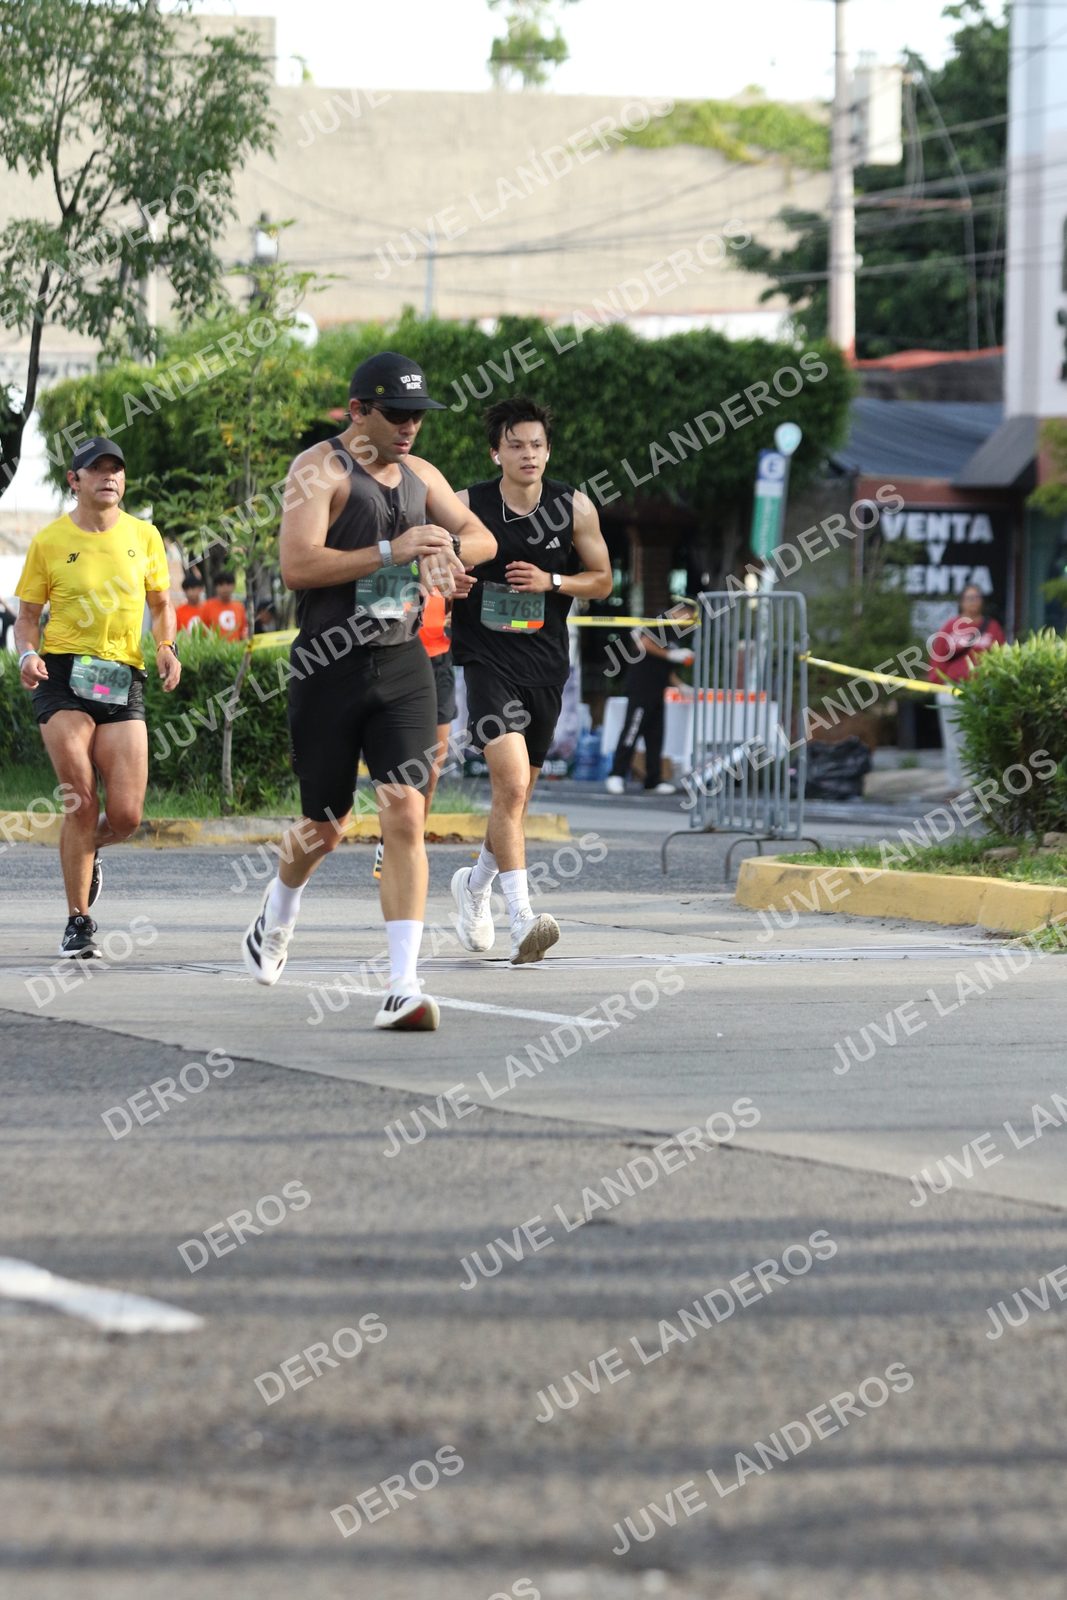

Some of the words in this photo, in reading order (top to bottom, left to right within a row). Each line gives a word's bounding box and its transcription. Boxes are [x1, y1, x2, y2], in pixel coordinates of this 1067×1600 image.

[880, 511, 994, 543] VENTA
[927, 541, 947, 565] Y
[497, 599, 543, 619] 1768
